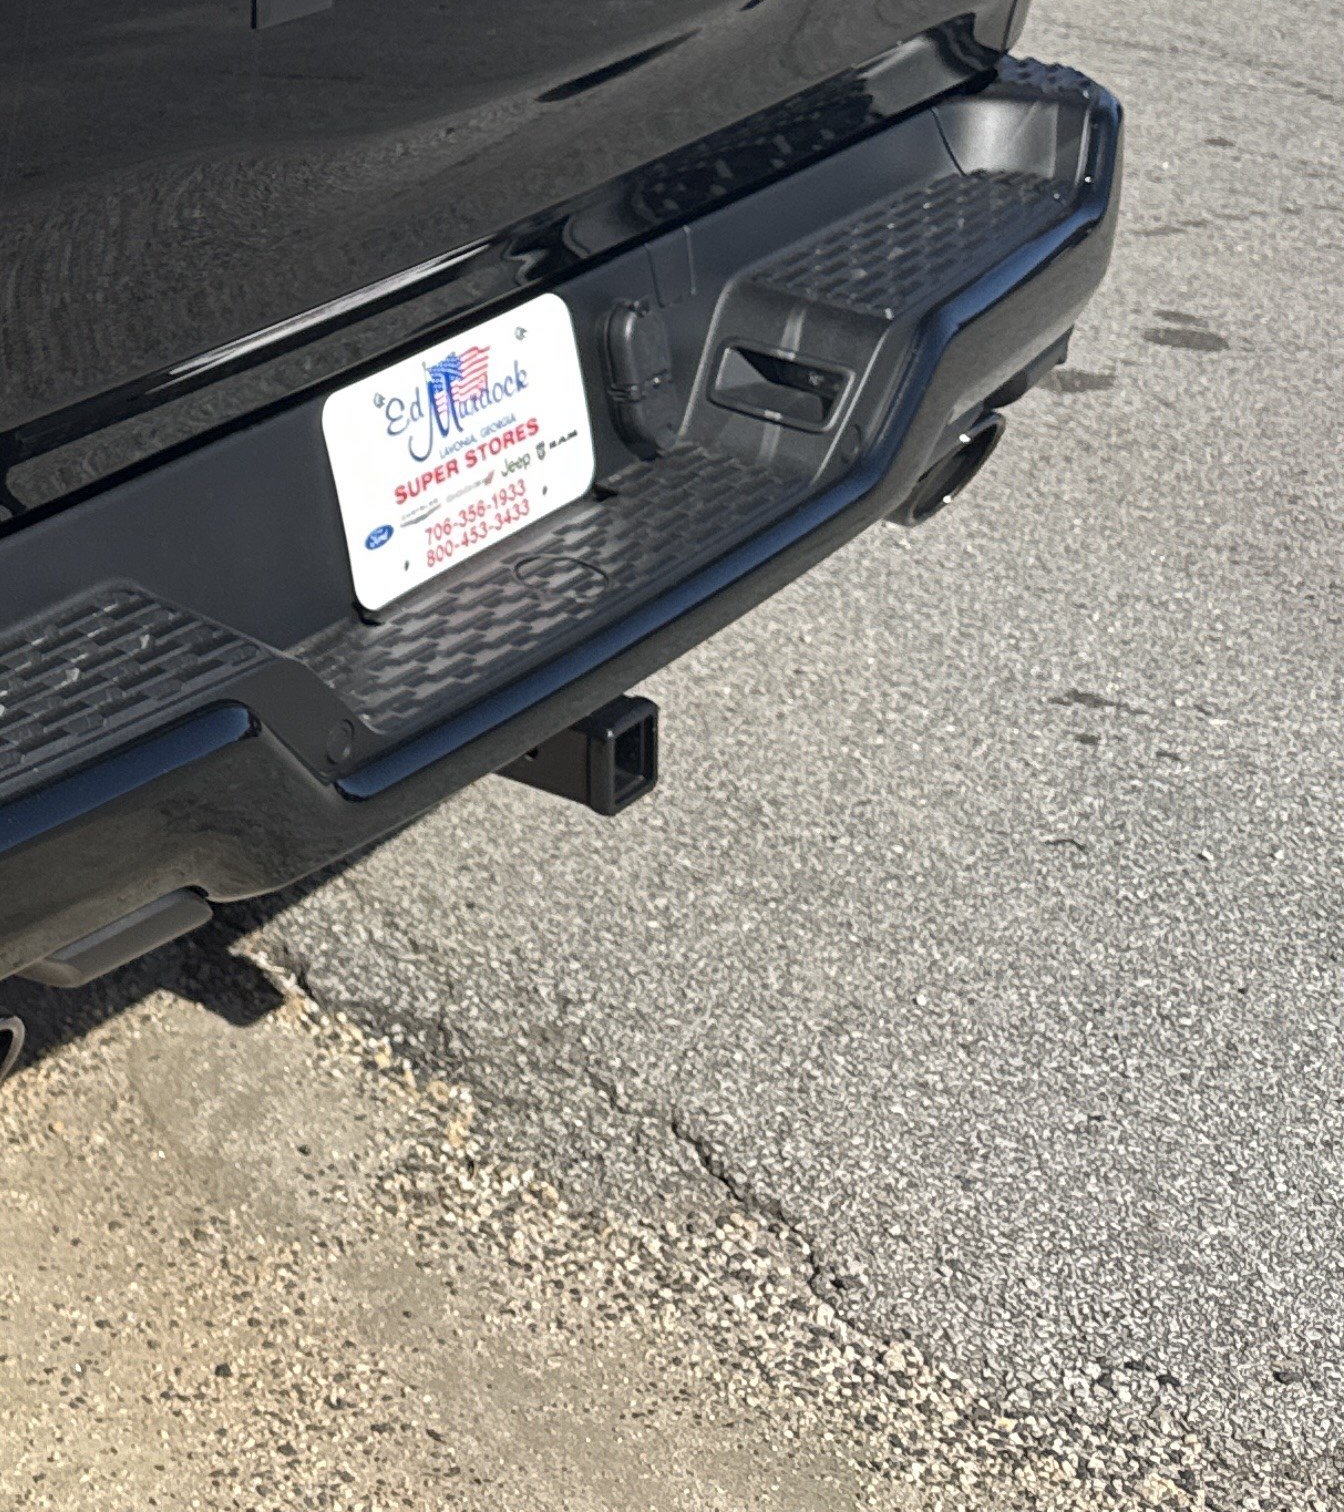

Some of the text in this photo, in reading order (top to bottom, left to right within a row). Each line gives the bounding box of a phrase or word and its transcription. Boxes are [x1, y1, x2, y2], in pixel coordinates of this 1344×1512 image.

[384, 384, 423, 437] Ed
[394, 459, 461, 506] SUPER
[465, 416, 541, 469] STORES
[500, 452, 531, 478] Jeep
[424, 478, 527, 546] 706-356-1933
[426, 498, 531, 568] 800-453-3433
